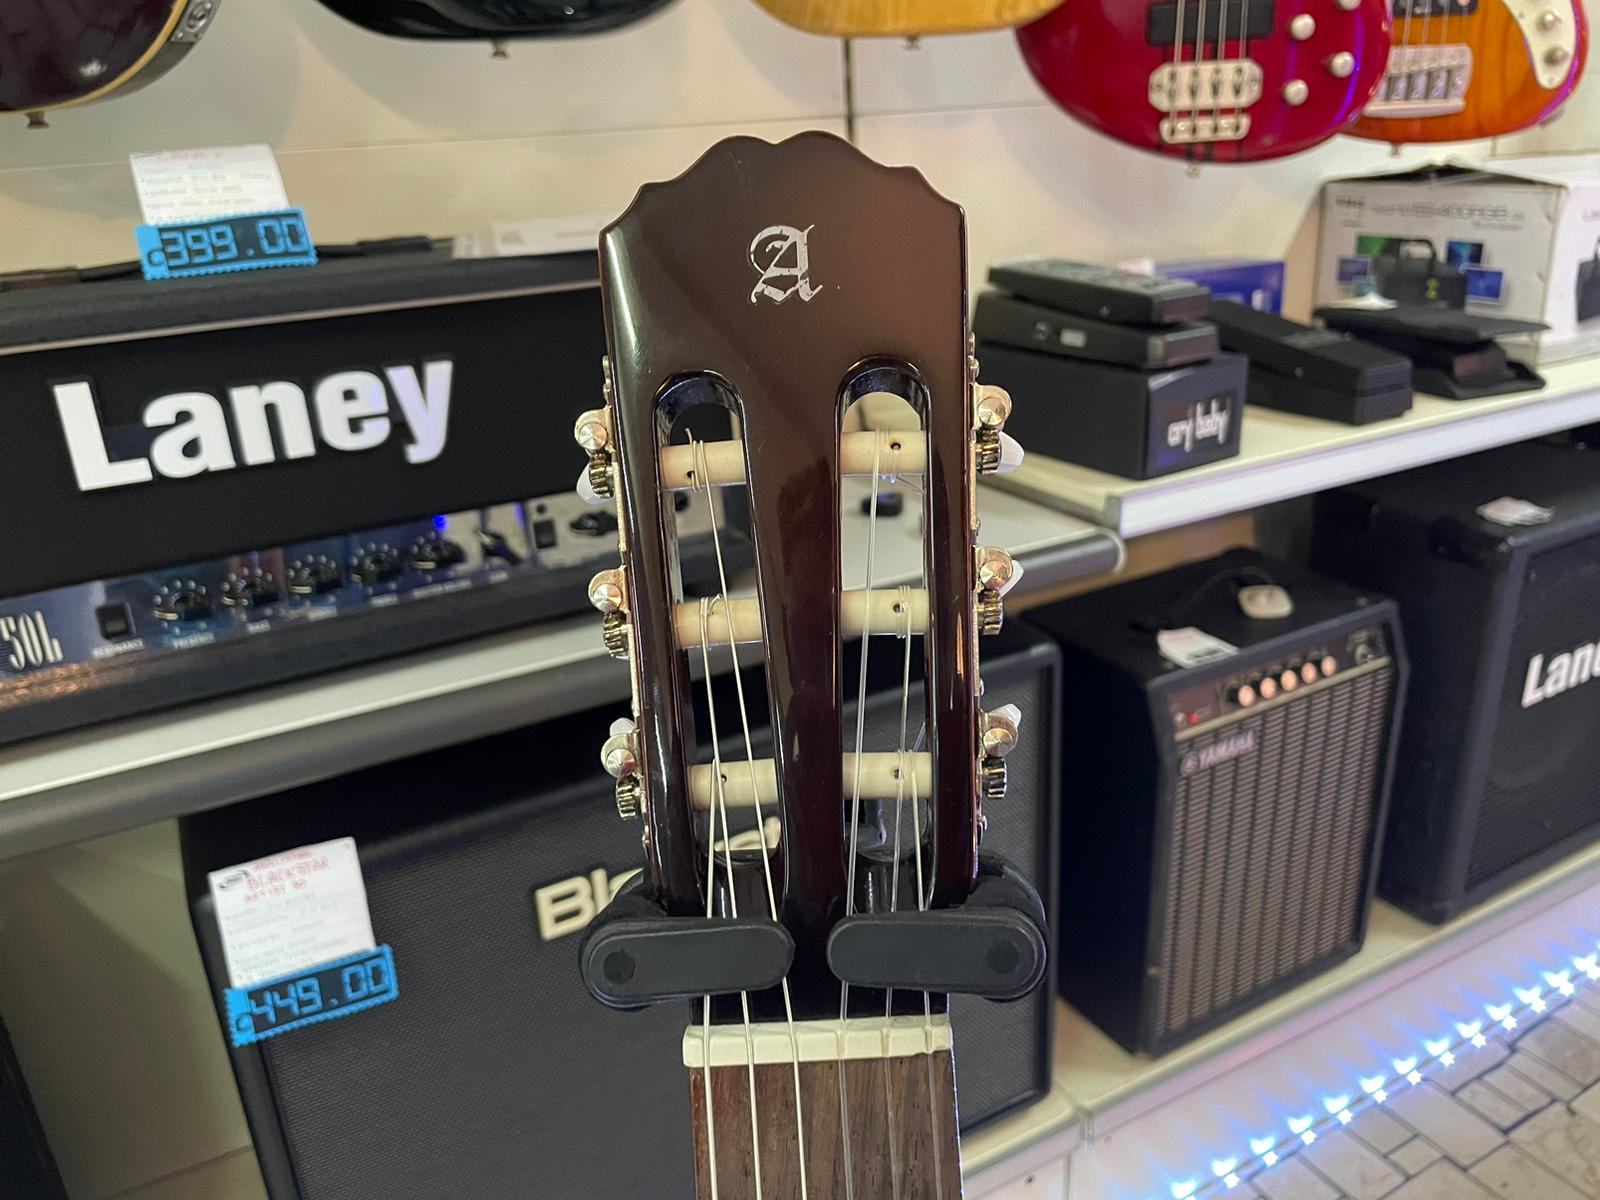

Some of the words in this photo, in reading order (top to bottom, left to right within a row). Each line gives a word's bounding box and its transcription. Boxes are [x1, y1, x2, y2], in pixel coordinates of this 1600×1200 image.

[161, 218, 308, 266] 399.00
[749, 224, 823, 303] A
[53, 360, 453, 491] Laney
[1167, 408, 1194, 453] cry
[1195, 398, 1231, 445] baby
[1199, 730, 1256, 770] YAMAHA
[534, 867, 644, 940] Bl
[250, 958, 390, 1024] 449.00
